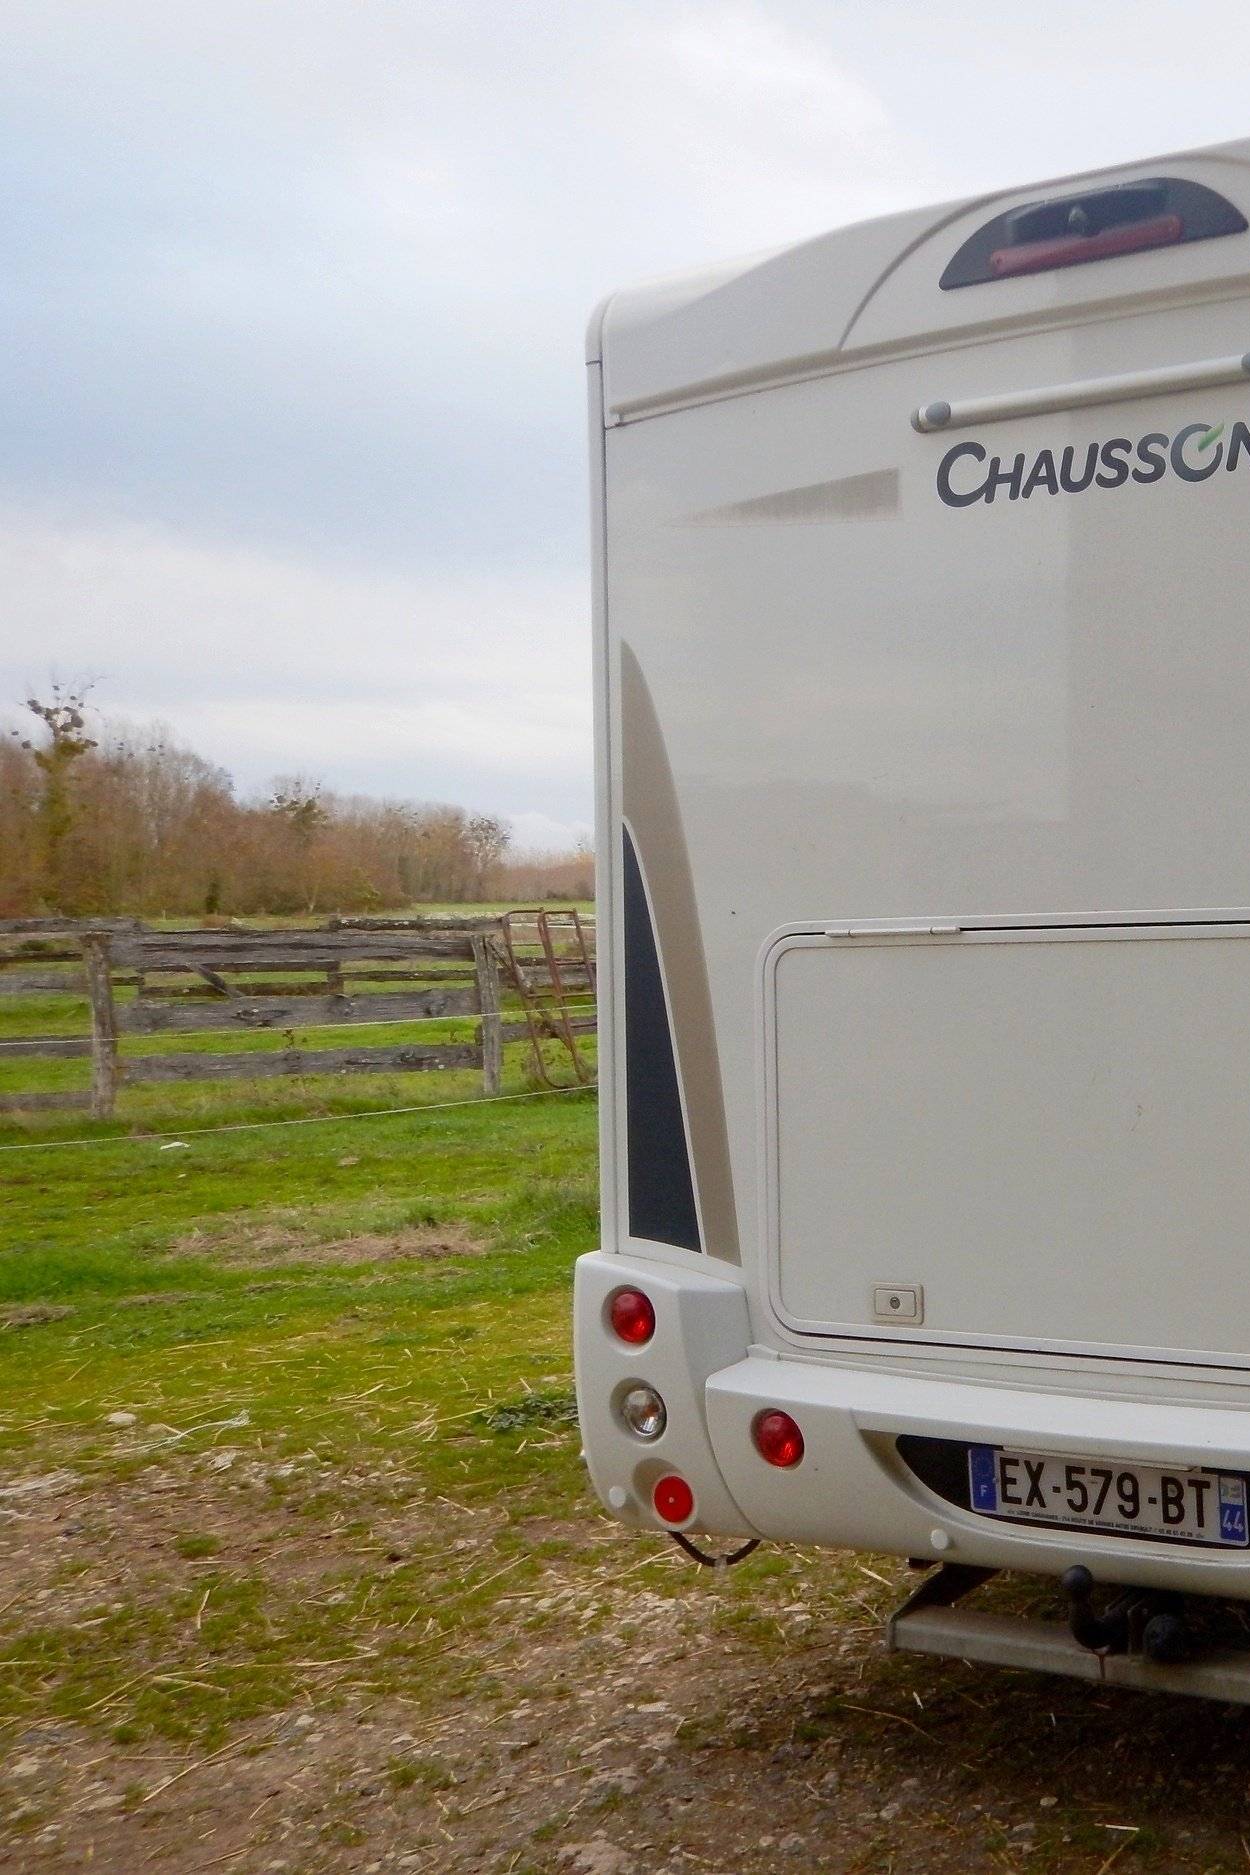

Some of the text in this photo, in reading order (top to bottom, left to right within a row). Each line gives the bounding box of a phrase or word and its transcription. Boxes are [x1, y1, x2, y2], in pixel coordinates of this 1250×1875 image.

[980, 1484, 988, 1497] F
[999, 1456, 1211, 1529] EX-579-BT
[1222, 1509, 1244, 1533] 44
